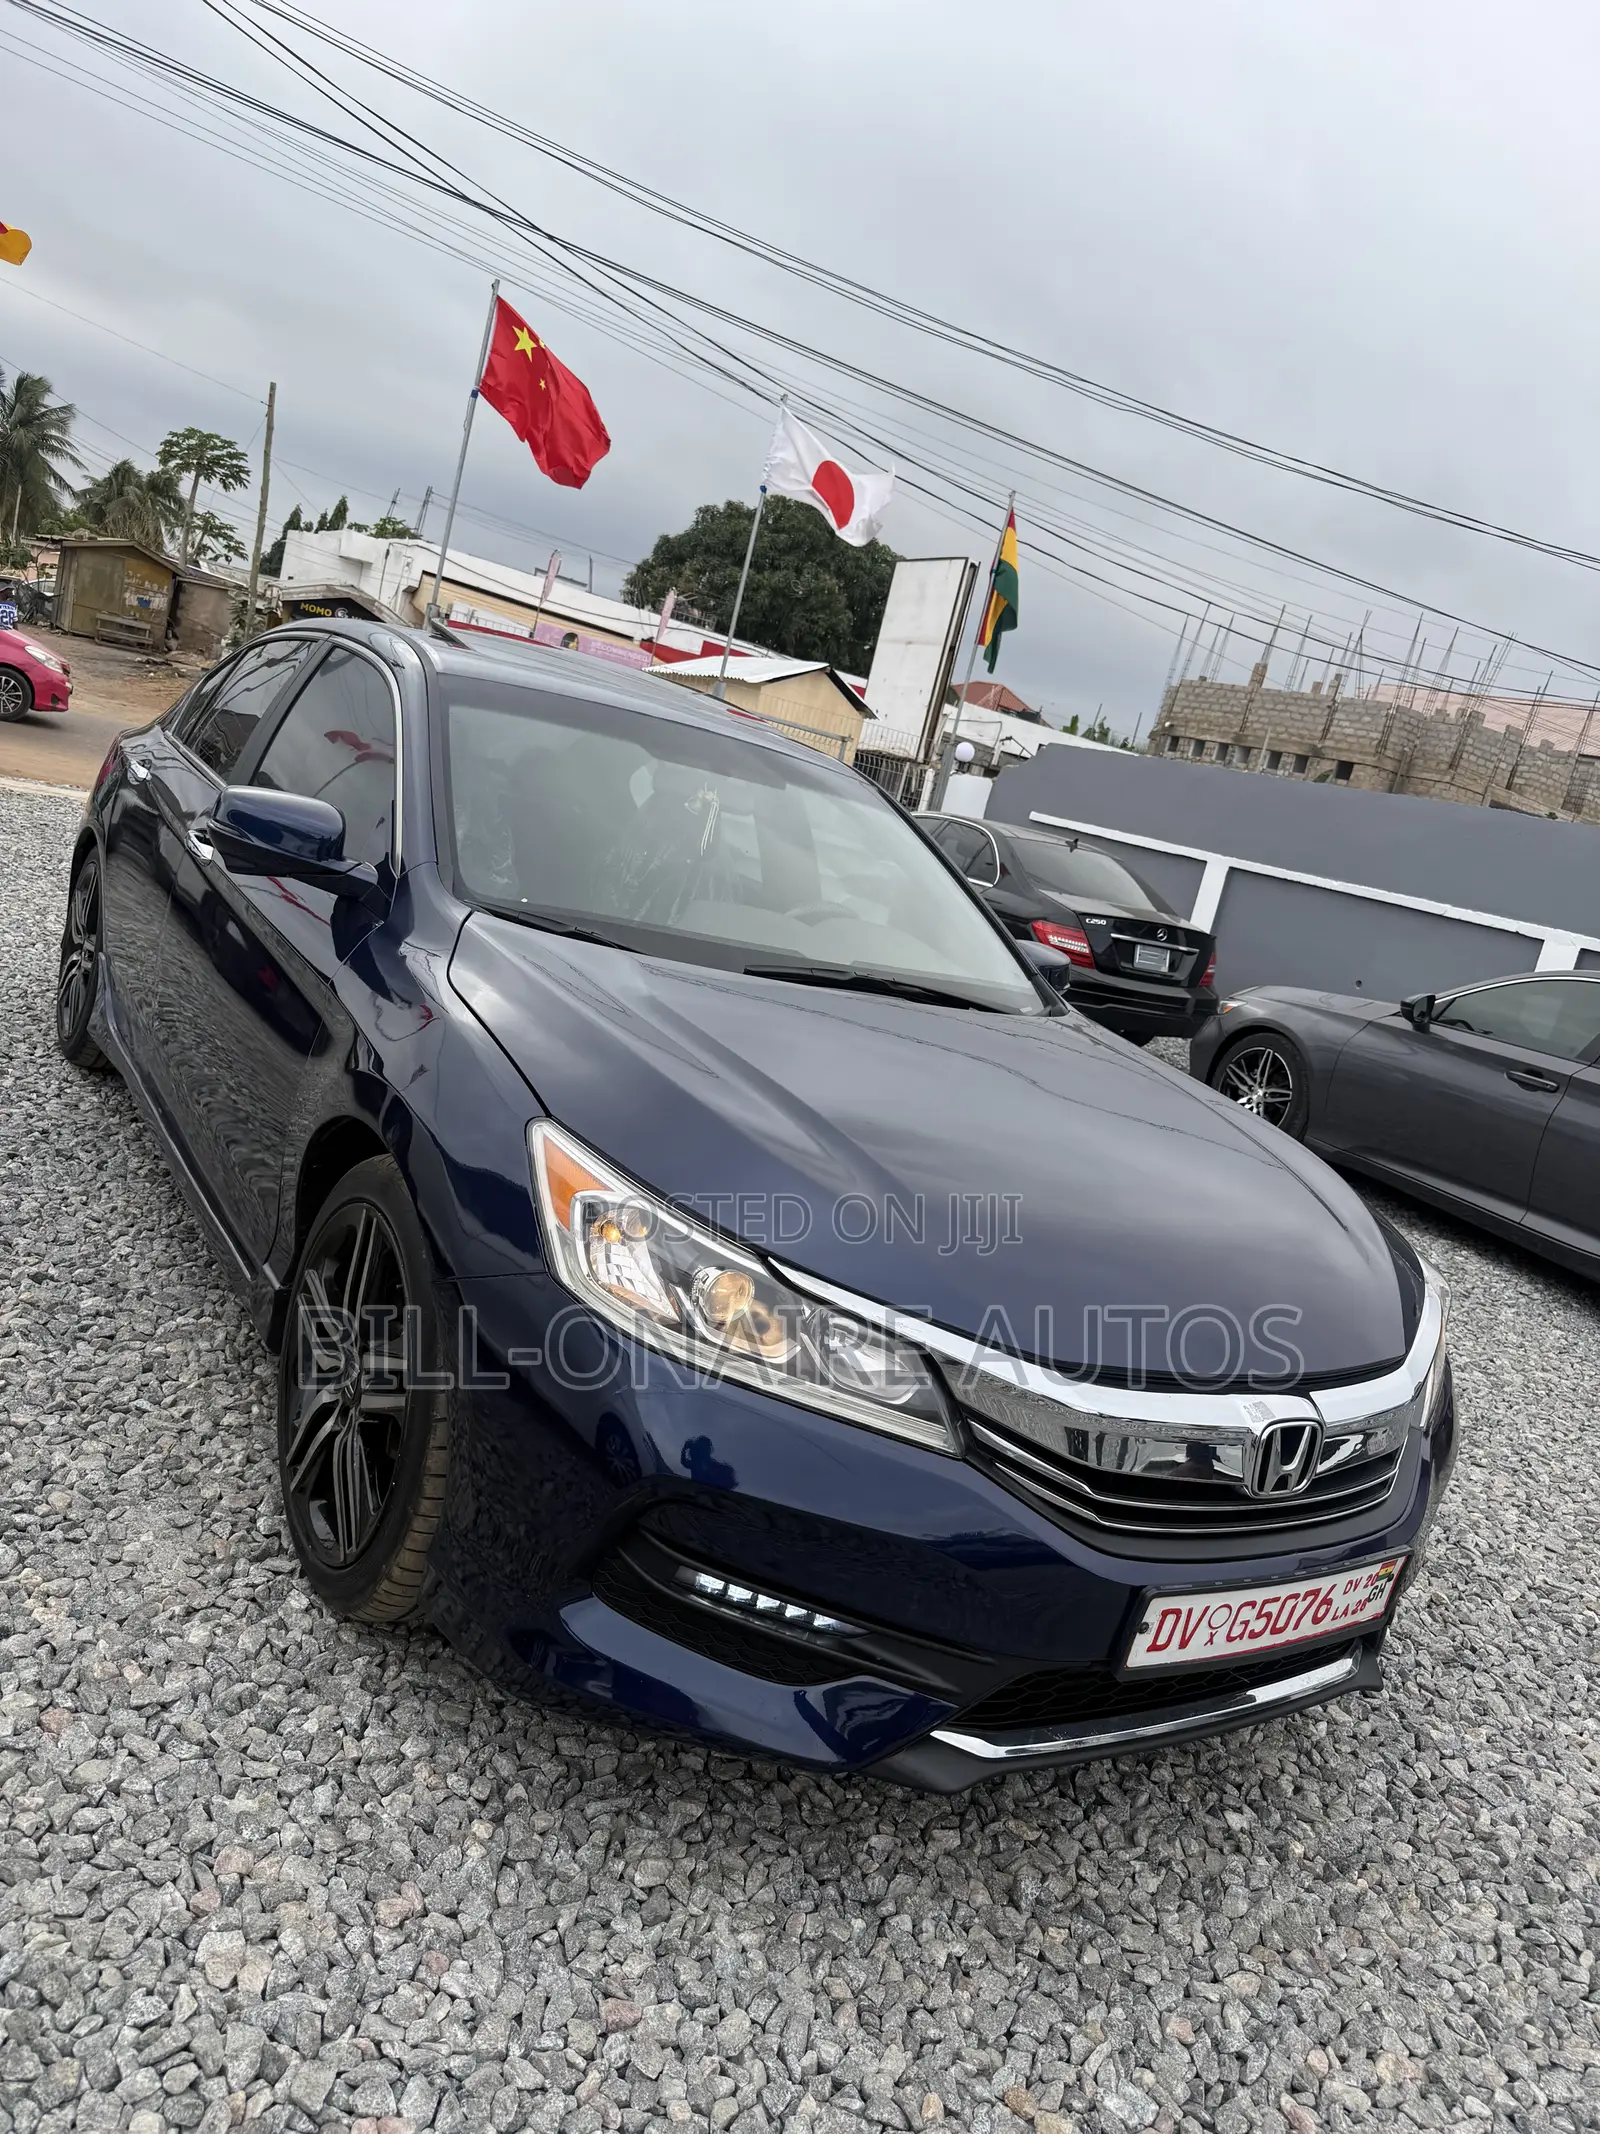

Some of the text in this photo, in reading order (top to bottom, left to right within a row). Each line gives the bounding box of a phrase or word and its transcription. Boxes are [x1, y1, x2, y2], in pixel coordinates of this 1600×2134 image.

[300, 602, 332, 617] MOMO
[1086, 918, 1107, 926] C250
[1343, 1576, 1363, 1595] DV
[1367, 1581, 1387, 1602] GH
[1146, 1606, 1210, 1652] DV
[1225, 1584, 1337, 1643] G5076
[1331, 1603, 1350, 1621] LA
